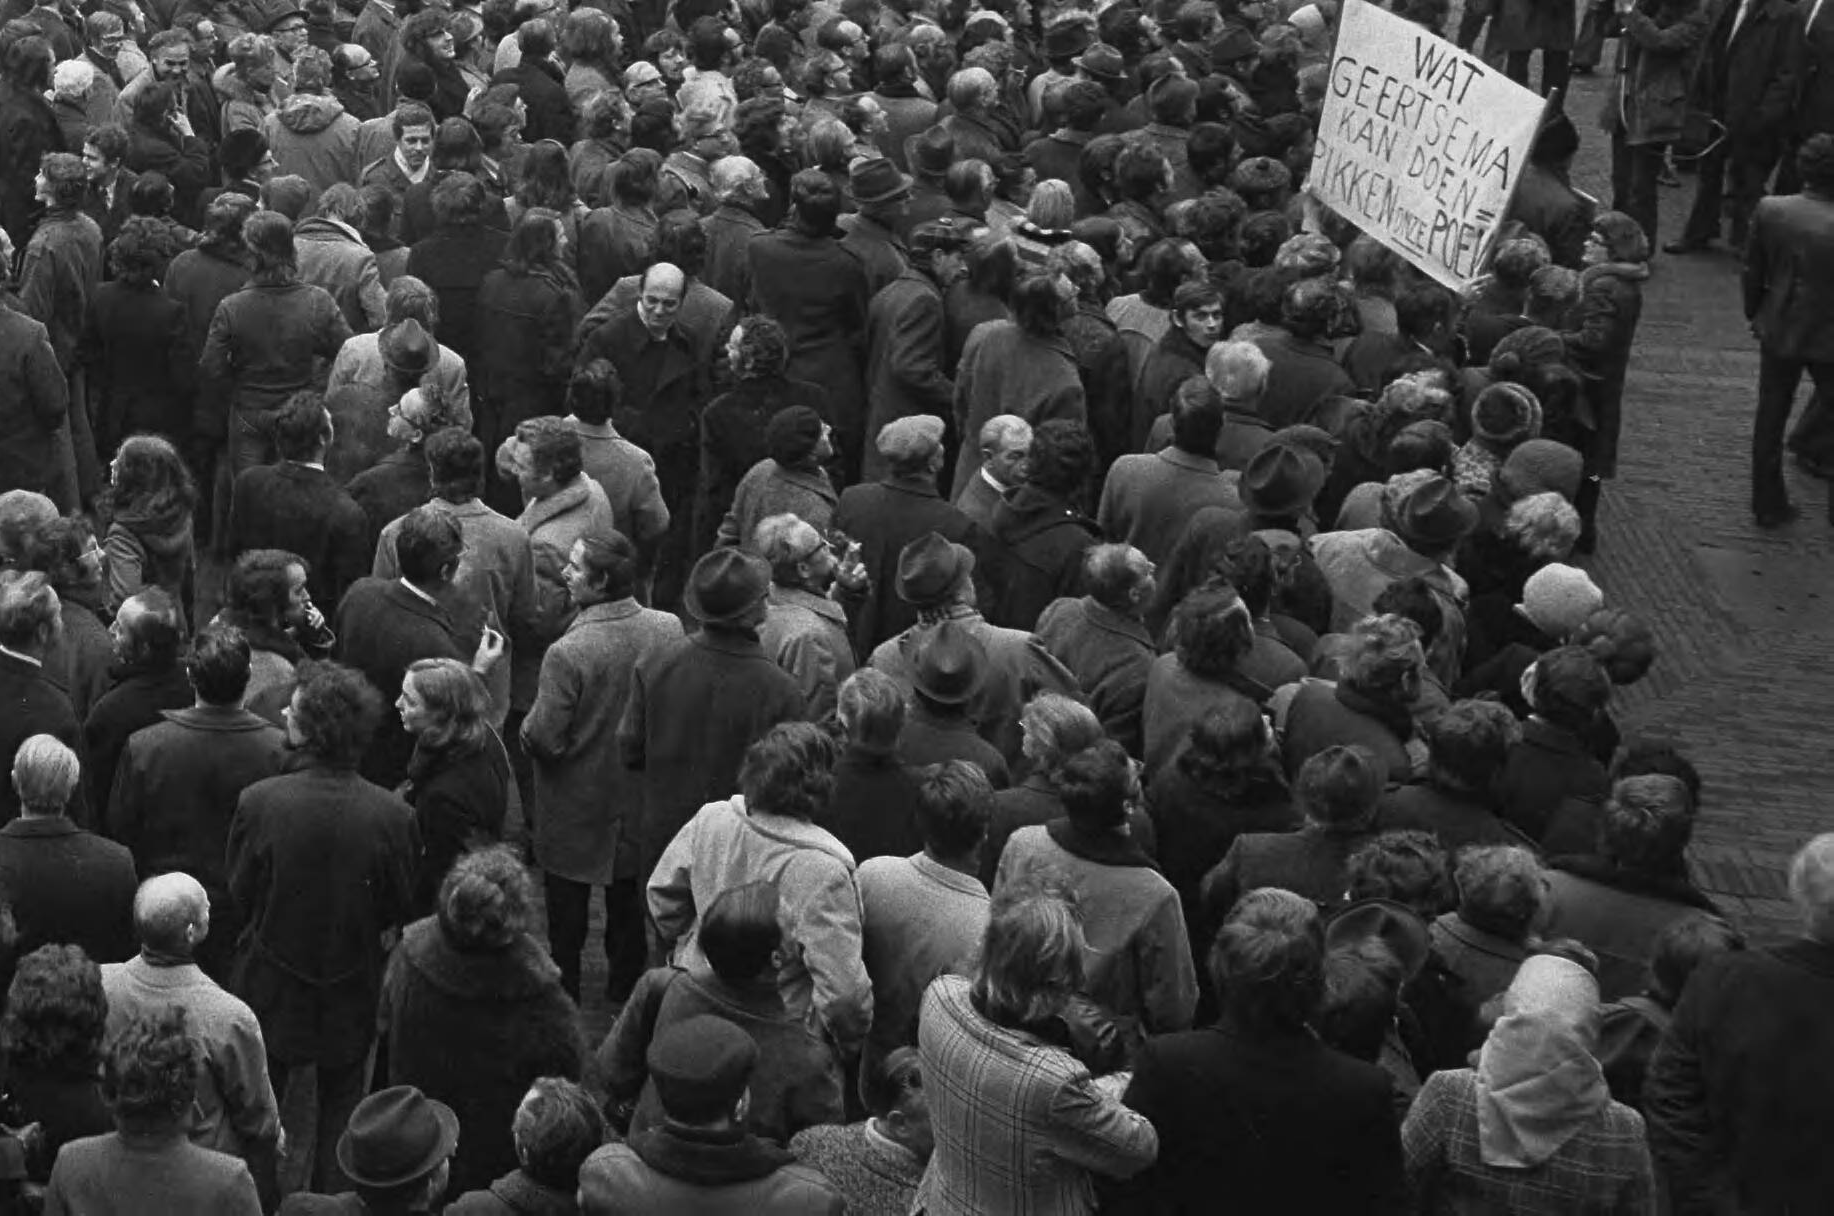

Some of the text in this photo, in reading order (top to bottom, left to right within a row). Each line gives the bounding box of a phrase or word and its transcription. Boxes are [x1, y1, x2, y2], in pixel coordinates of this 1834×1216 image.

[1414, 36, 1485, 105] WAT
[1331, 55, 1511, 191] GEERTSEMA
[1338, 109, 1398, 165] KAN
[1407, 145, 1478, 220] DOEN
[1313, 137, 1400, 229] PIKKEN
